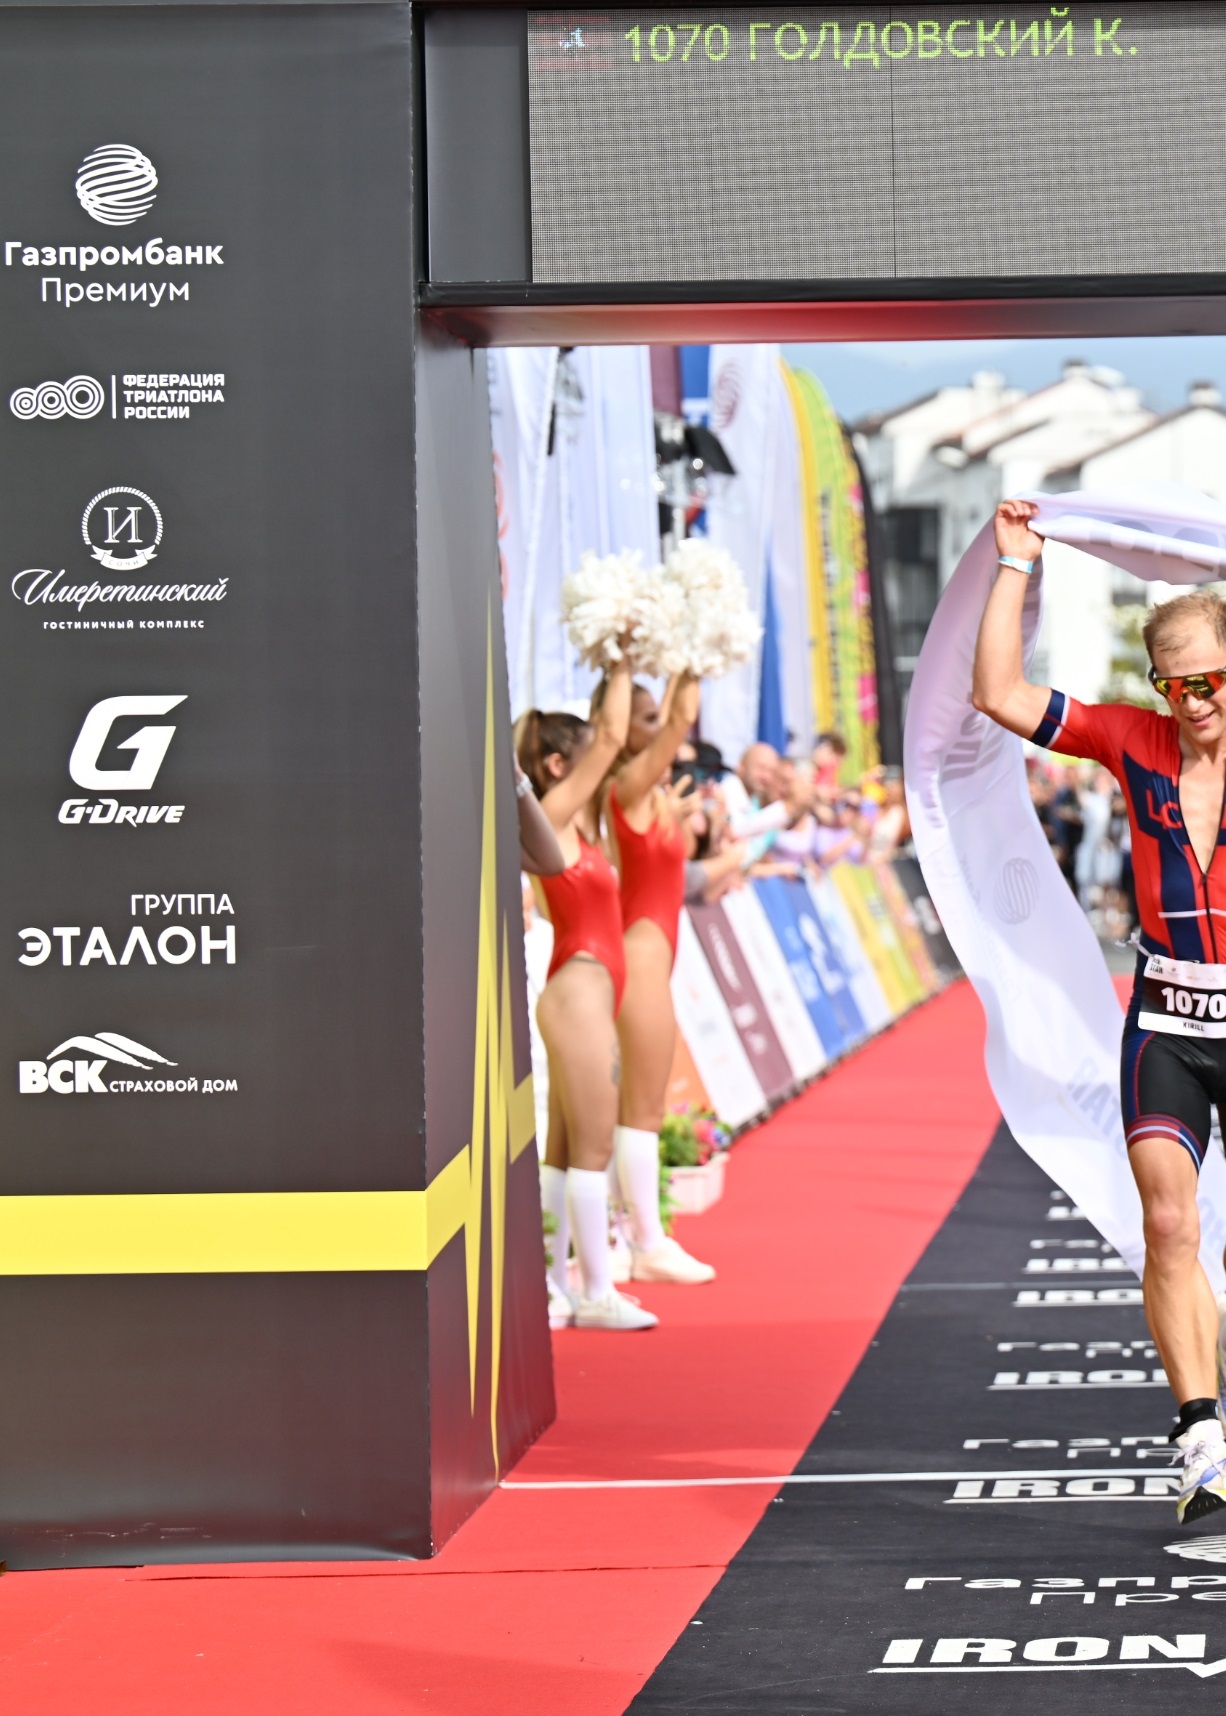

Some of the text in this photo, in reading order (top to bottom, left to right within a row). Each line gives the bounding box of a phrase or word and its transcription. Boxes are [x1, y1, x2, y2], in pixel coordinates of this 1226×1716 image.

[625, 23, 731, 63] 1070
[749, 6, 1076, 69] ГОЛДОВСКИЙ
[1094, 17, 1139, 57] К.
[4, 237, 225, 272] Газпромбанк
[41, 277, 190, 308] Премиум
[122, 373, 225, 389] ФЕДЕРАЦИЯ
[123, 389, 225, 404] ТРИАТЛОНА
[124, 405, 190, 419] РОССИИ
[103, 506, 143, 544] И
[11, 568, 230, 613] Имеретинский
[43, 618, 206, 630] ГОСТИНИЧНЫЙ КОМПЛЕКС
[131, 893, 235, 916] ГРУППА
[17, 925, 236, 967] ЭТАЛОН
[1183, 1021, 1205, 1032] KIRILL
[19, 1060, 238, 1094] ВСК СТРАХОВОЙ ДОМ
[1016, 1288, 1144, 1300] IRO
[993, 1368, 1170, 1385] IRO
[882, 1633, 1206, 1665] IRON
